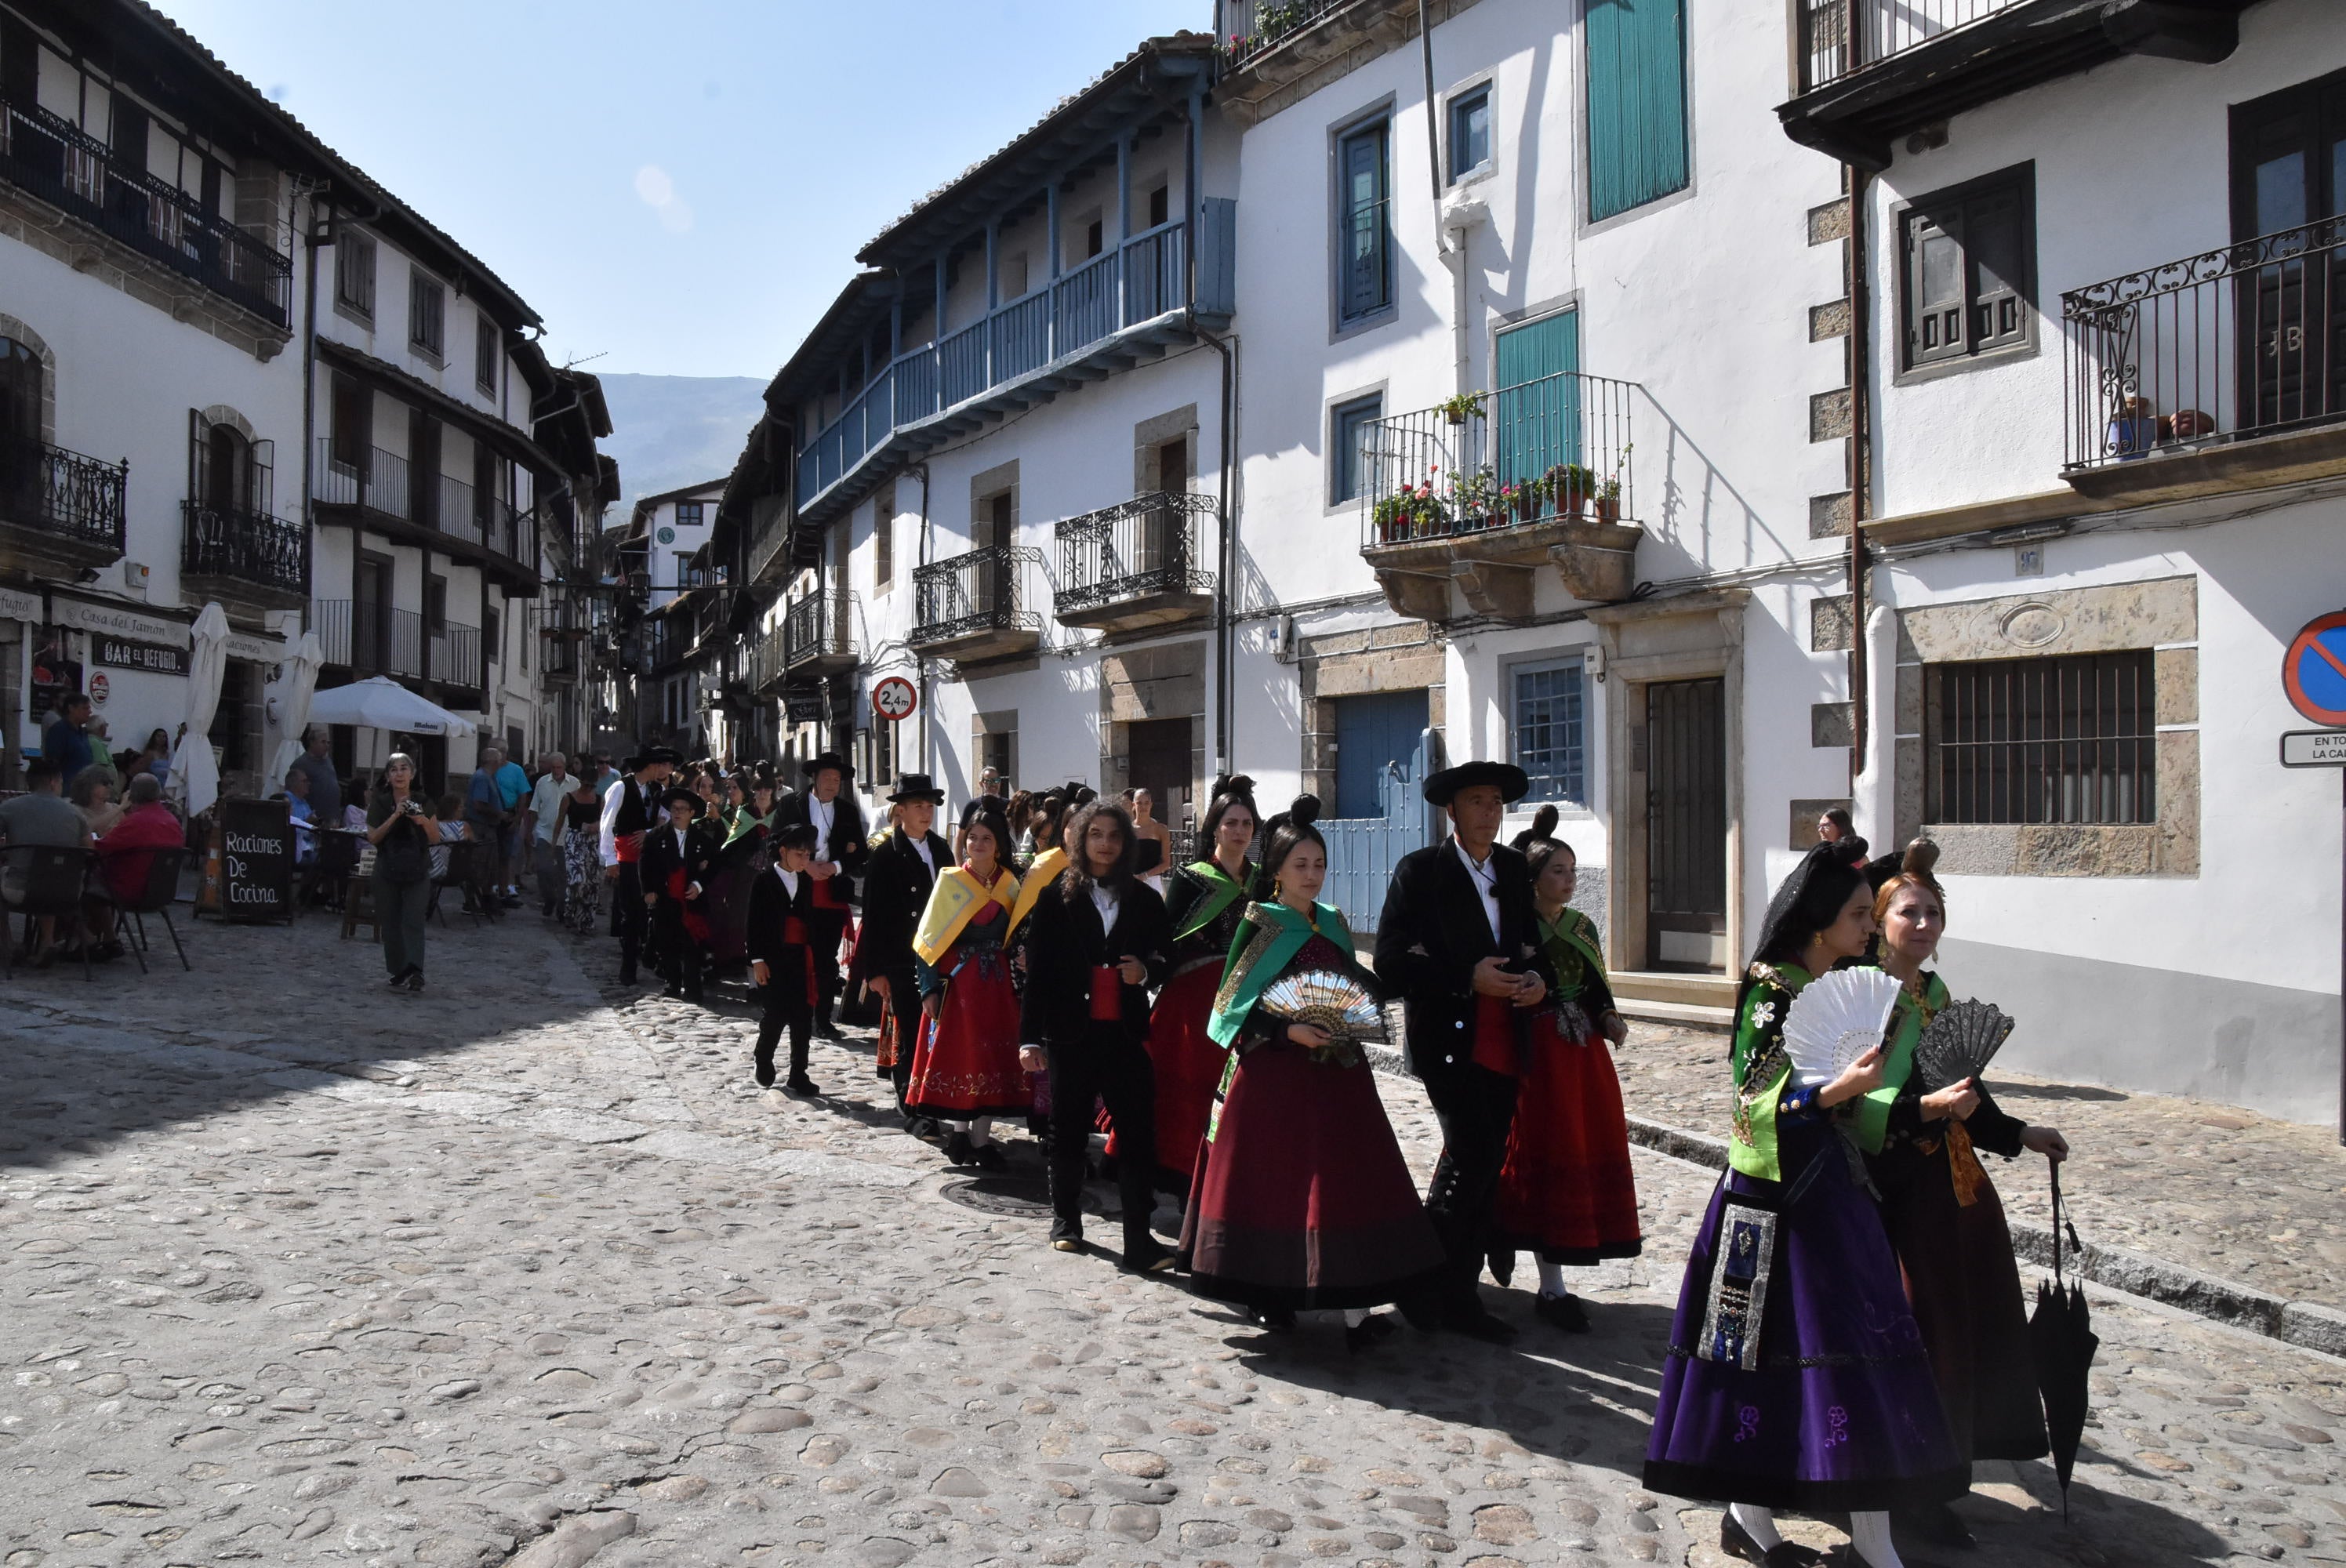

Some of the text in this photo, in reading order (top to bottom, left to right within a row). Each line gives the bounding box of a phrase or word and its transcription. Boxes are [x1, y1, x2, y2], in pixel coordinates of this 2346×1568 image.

[81, 608, 107, 625] Casa
[111, 615, 129, 629] del
[104, 641, 132, 665] BAR
[133, 648, 142, 662] EL
[226, 640, 260, 654] aciones
[414, 721, 438, 730] Mahou
[2315, 736, 2346, 746] EN TO
[2313, 750, 2326, 758] LA
[225, 830, 283, 855] Raciones
[225, 855, 248, 879] De
[230, 881, 279, 903] Cocina
